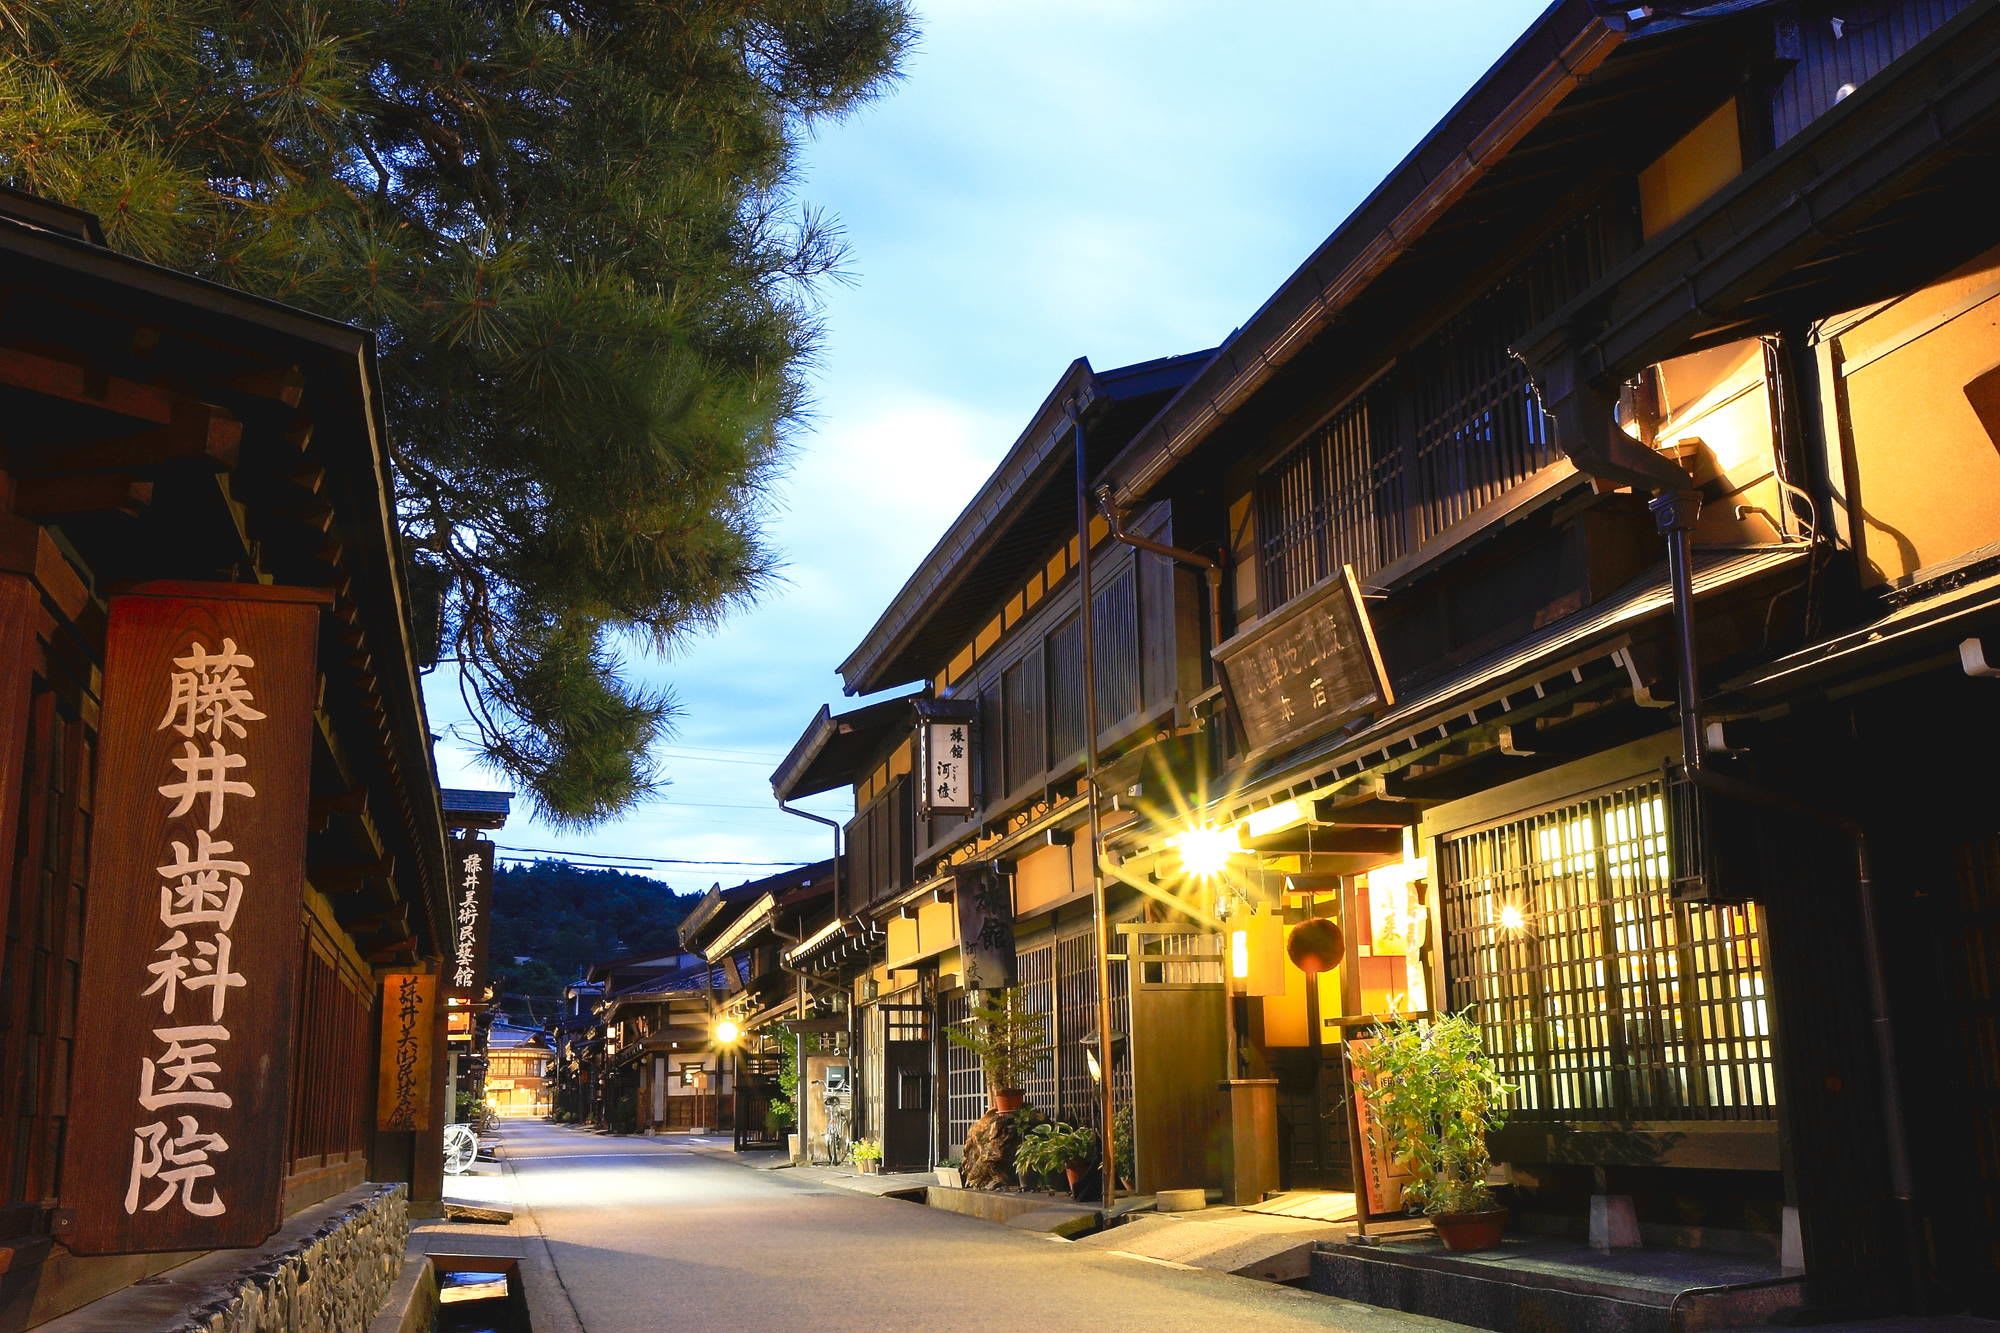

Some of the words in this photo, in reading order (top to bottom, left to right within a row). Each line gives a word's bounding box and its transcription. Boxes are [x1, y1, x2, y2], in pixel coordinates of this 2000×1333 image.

[949, 727, 965, 759] 旅館
[125, 638, 267, 1217] 藤井歯科医院
[453, 853, 482, 987] 藤井美術民藝館
